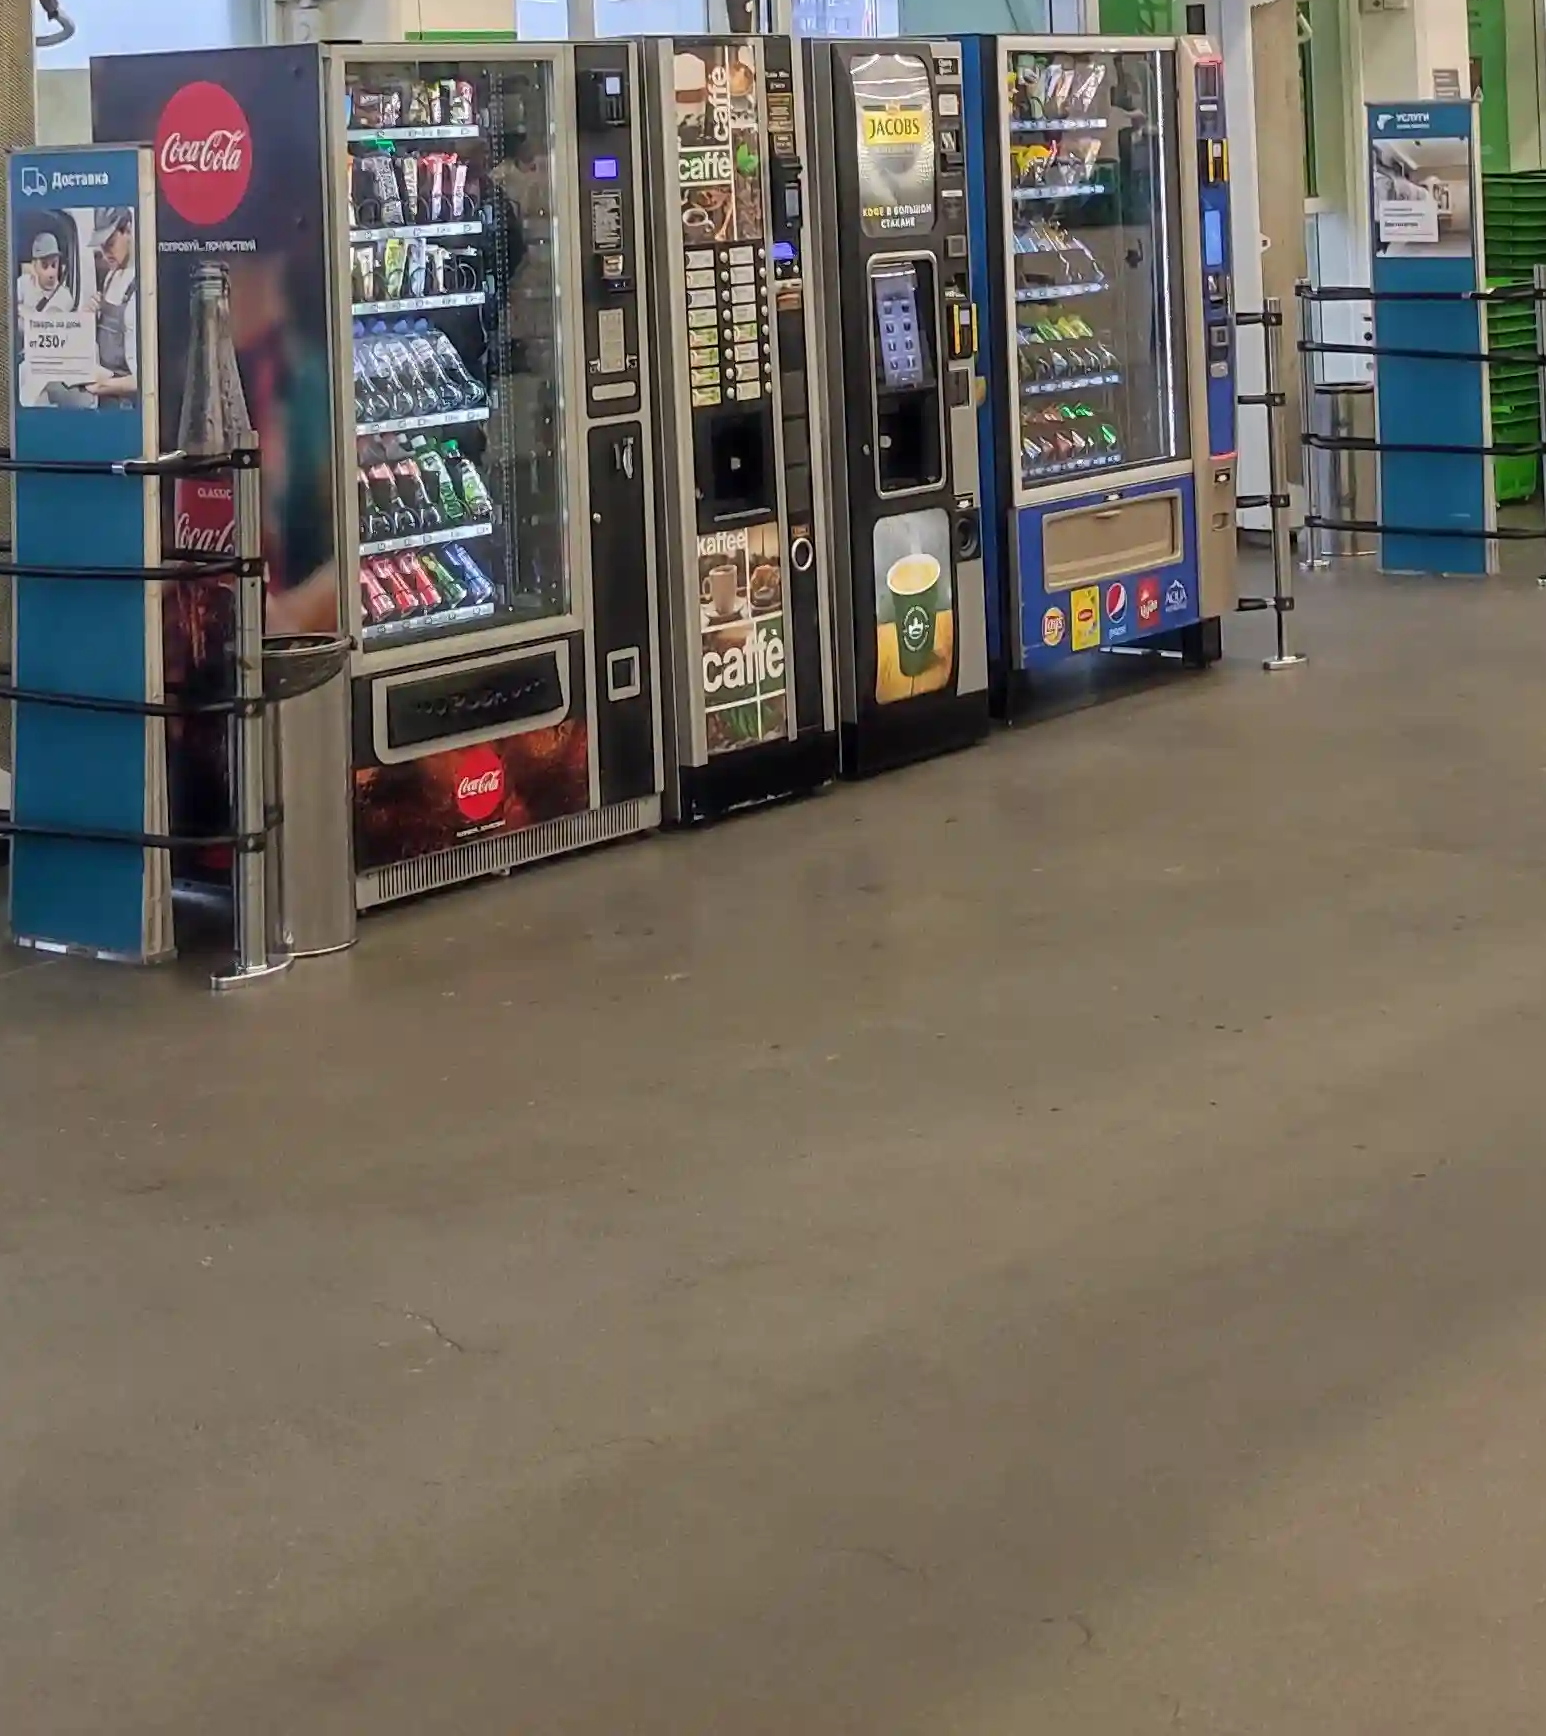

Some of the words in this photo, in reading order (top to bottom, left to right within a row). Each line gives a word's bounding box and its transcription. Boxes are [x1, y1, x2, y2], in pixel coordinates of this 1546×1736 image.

[869, 118, 920, 139] JACOBS
[161, 130, 245, 173] Coca-Cola
[678, 150, 732, 180] caffè
[52, 171, 109, 190] Доставка
[39, 334, 59, 348] 250
[697, 531, 747, 556] kaffee
[703, 628, 785, 693] caffè
[458, 769, 502, 799] Coca-Cola
